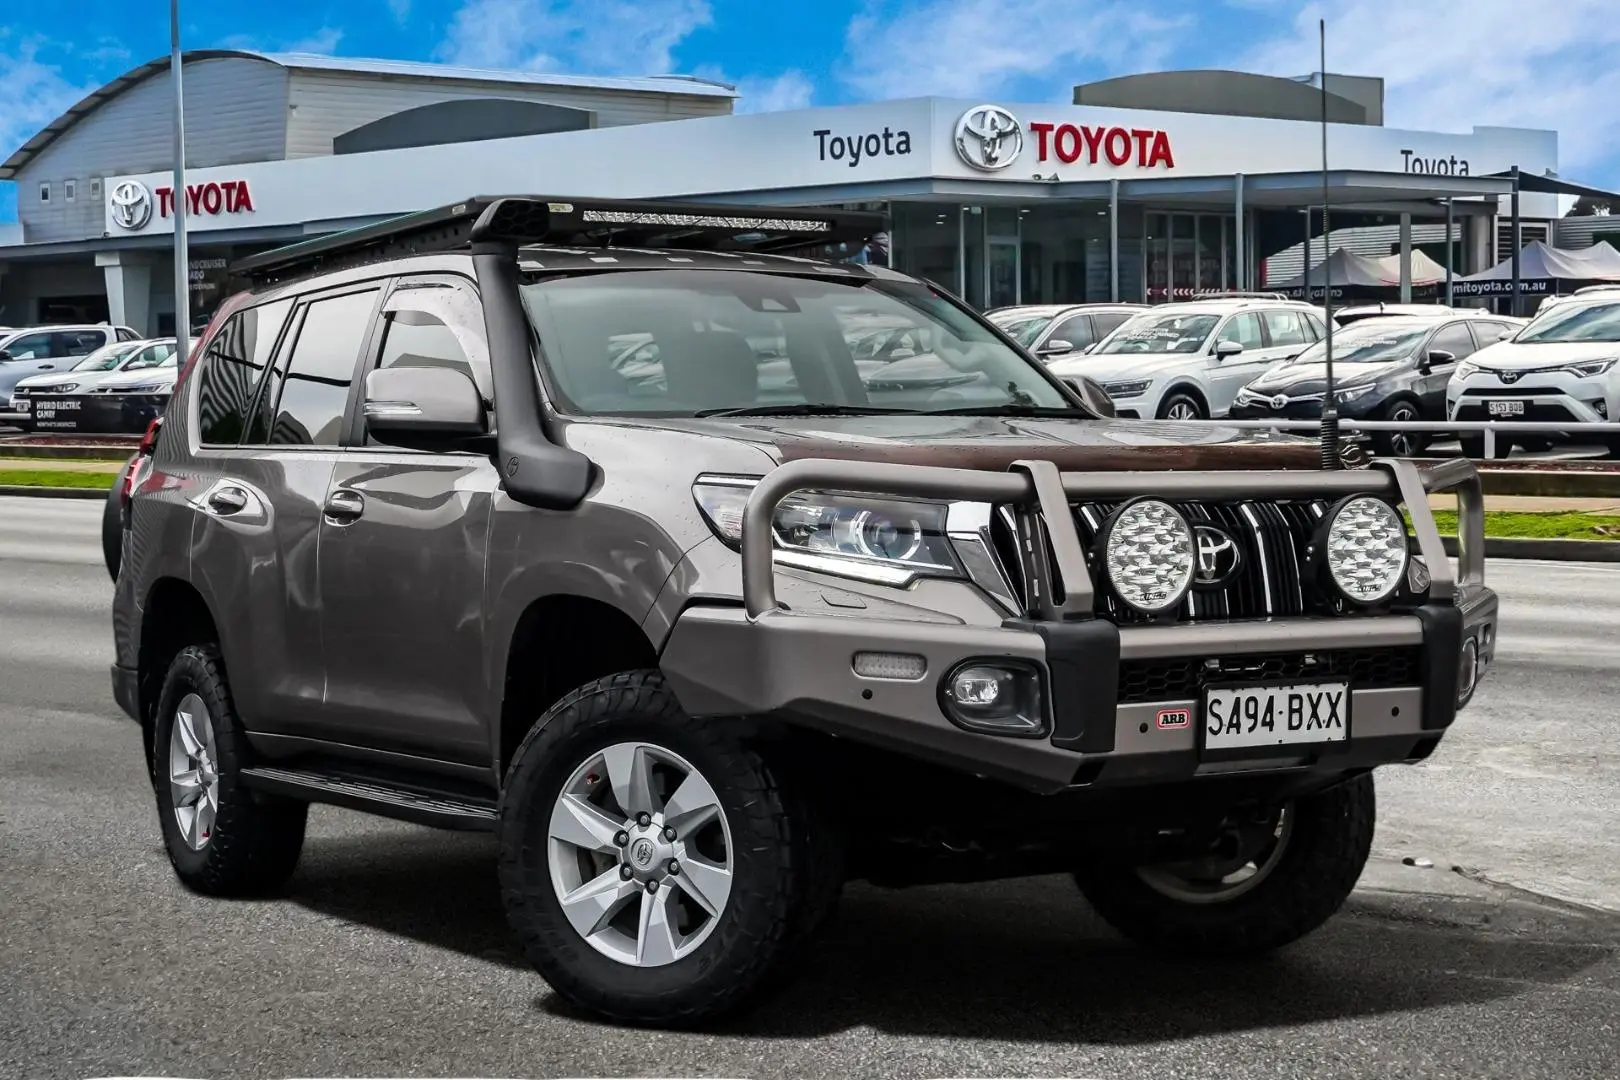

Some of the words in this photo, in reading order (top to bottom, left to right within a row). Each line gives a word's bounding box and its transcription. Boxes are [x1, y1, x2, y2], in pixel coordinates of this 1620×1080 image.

[813, 126, 912, 168] Toyota
[1029, 122, 1174, 169] TOYOTA
[1161, 713, 1186, 725] ARB
